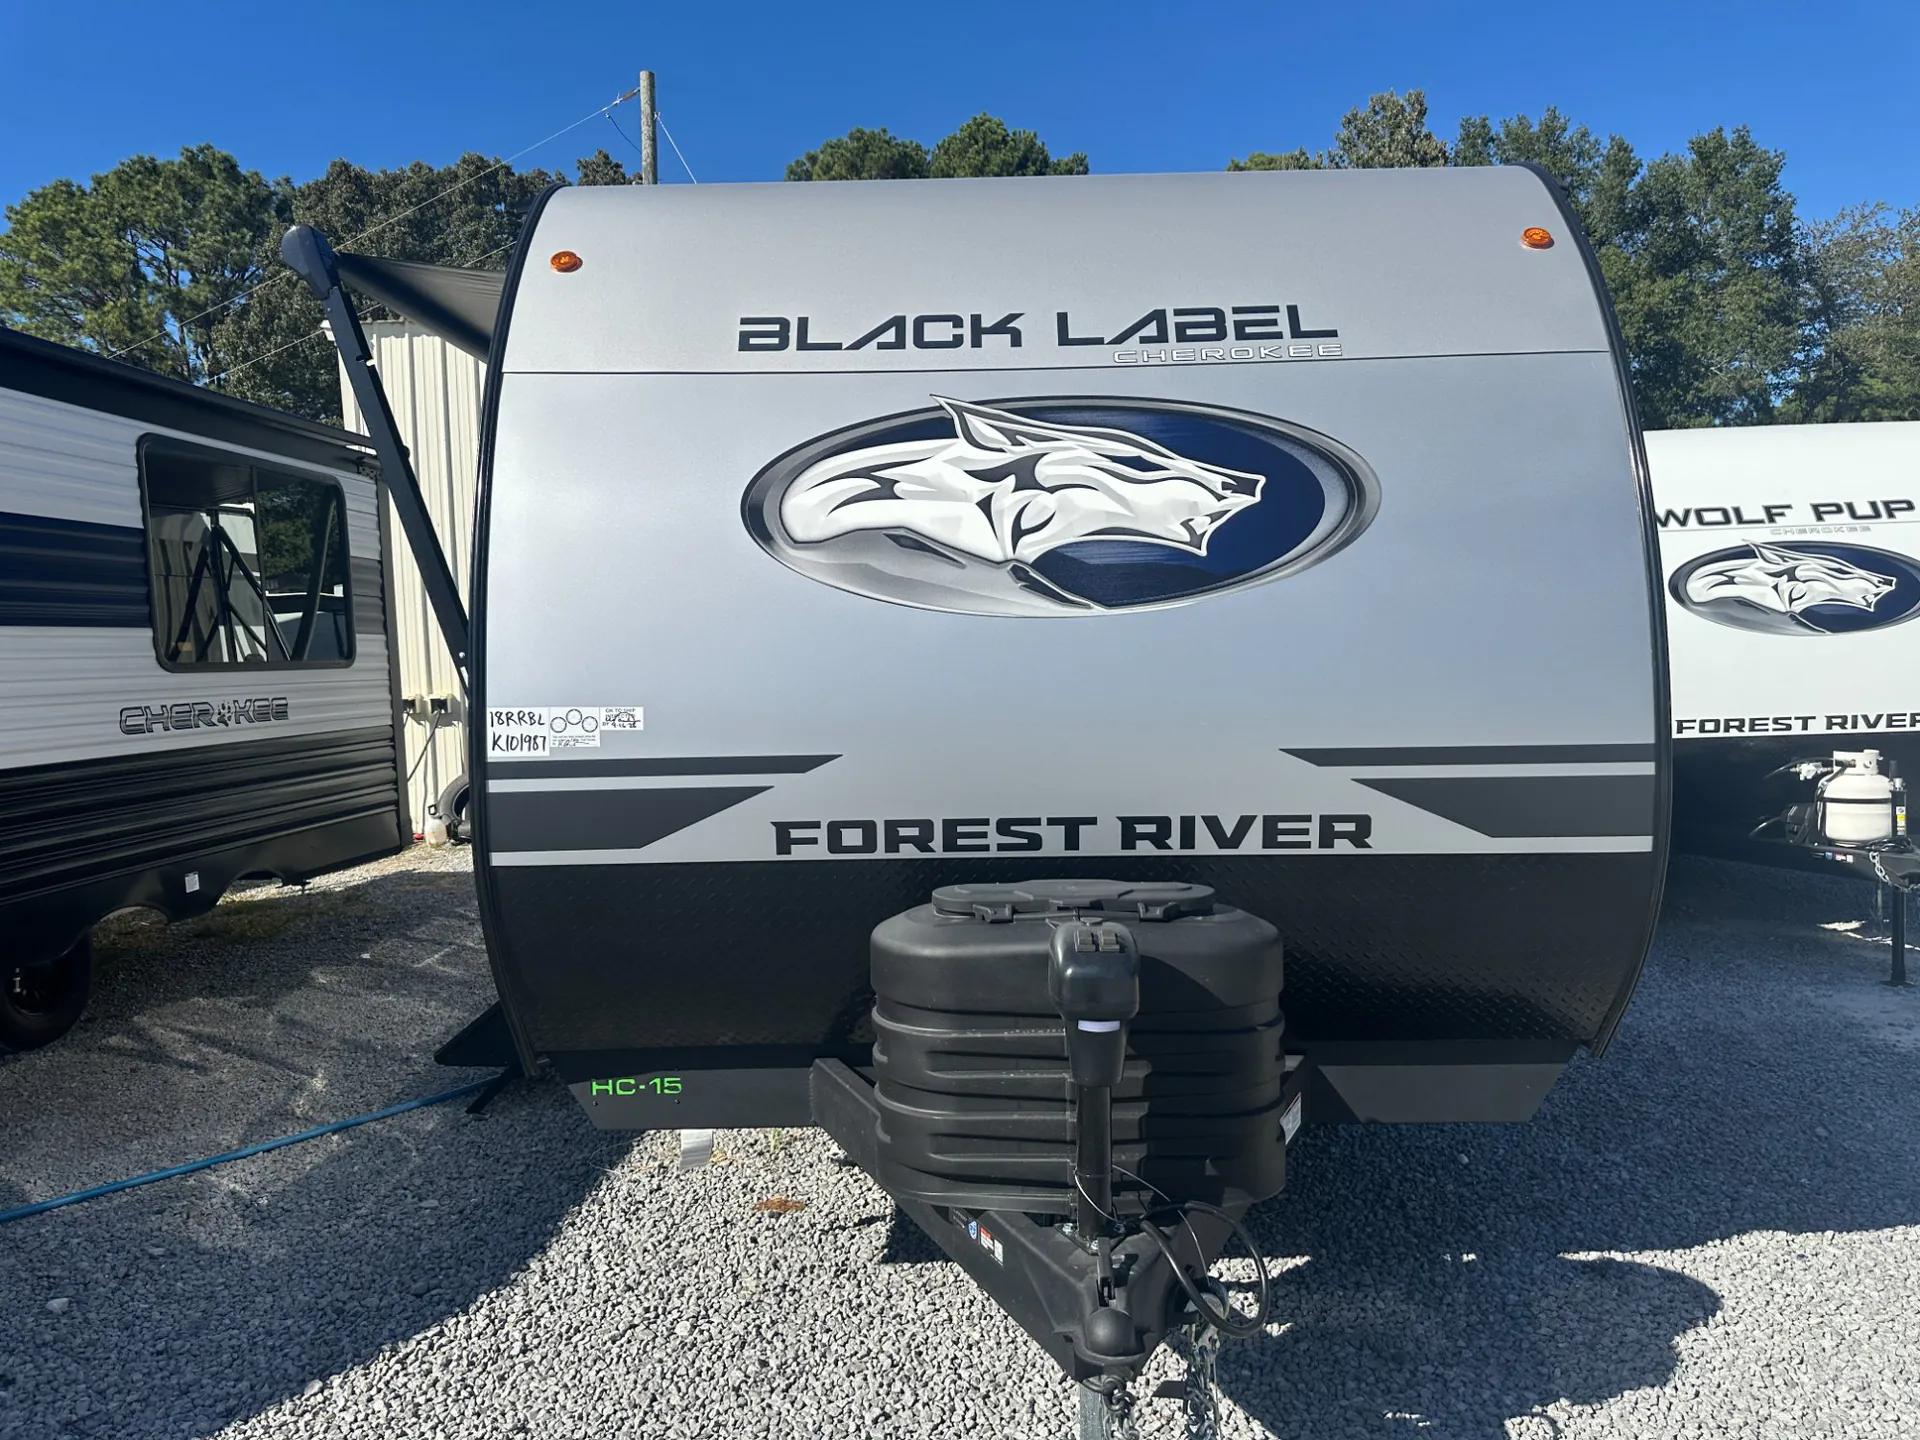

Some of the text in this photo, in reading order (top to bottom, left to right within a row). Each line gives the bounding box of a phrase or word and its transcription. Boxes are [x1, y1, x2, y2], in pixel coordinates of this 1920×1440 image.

[738, 304, 1339, 352] BLACK LABEL
[1113, 343, 1343, 364] CHEROKEE
[1655, 498, 1916, 528] WOLF PUP
[1769, 525, 1872, 536] CHEROKEE
[489, 710, 546, 728] 18RRBL
[1675, 715, 1817, 735] FOREST
[491, 731, 547, 753] K101987
[769, 812, 1374, 856] FOREST RIVER
[591, 1077, 682, 1096] HC-15
